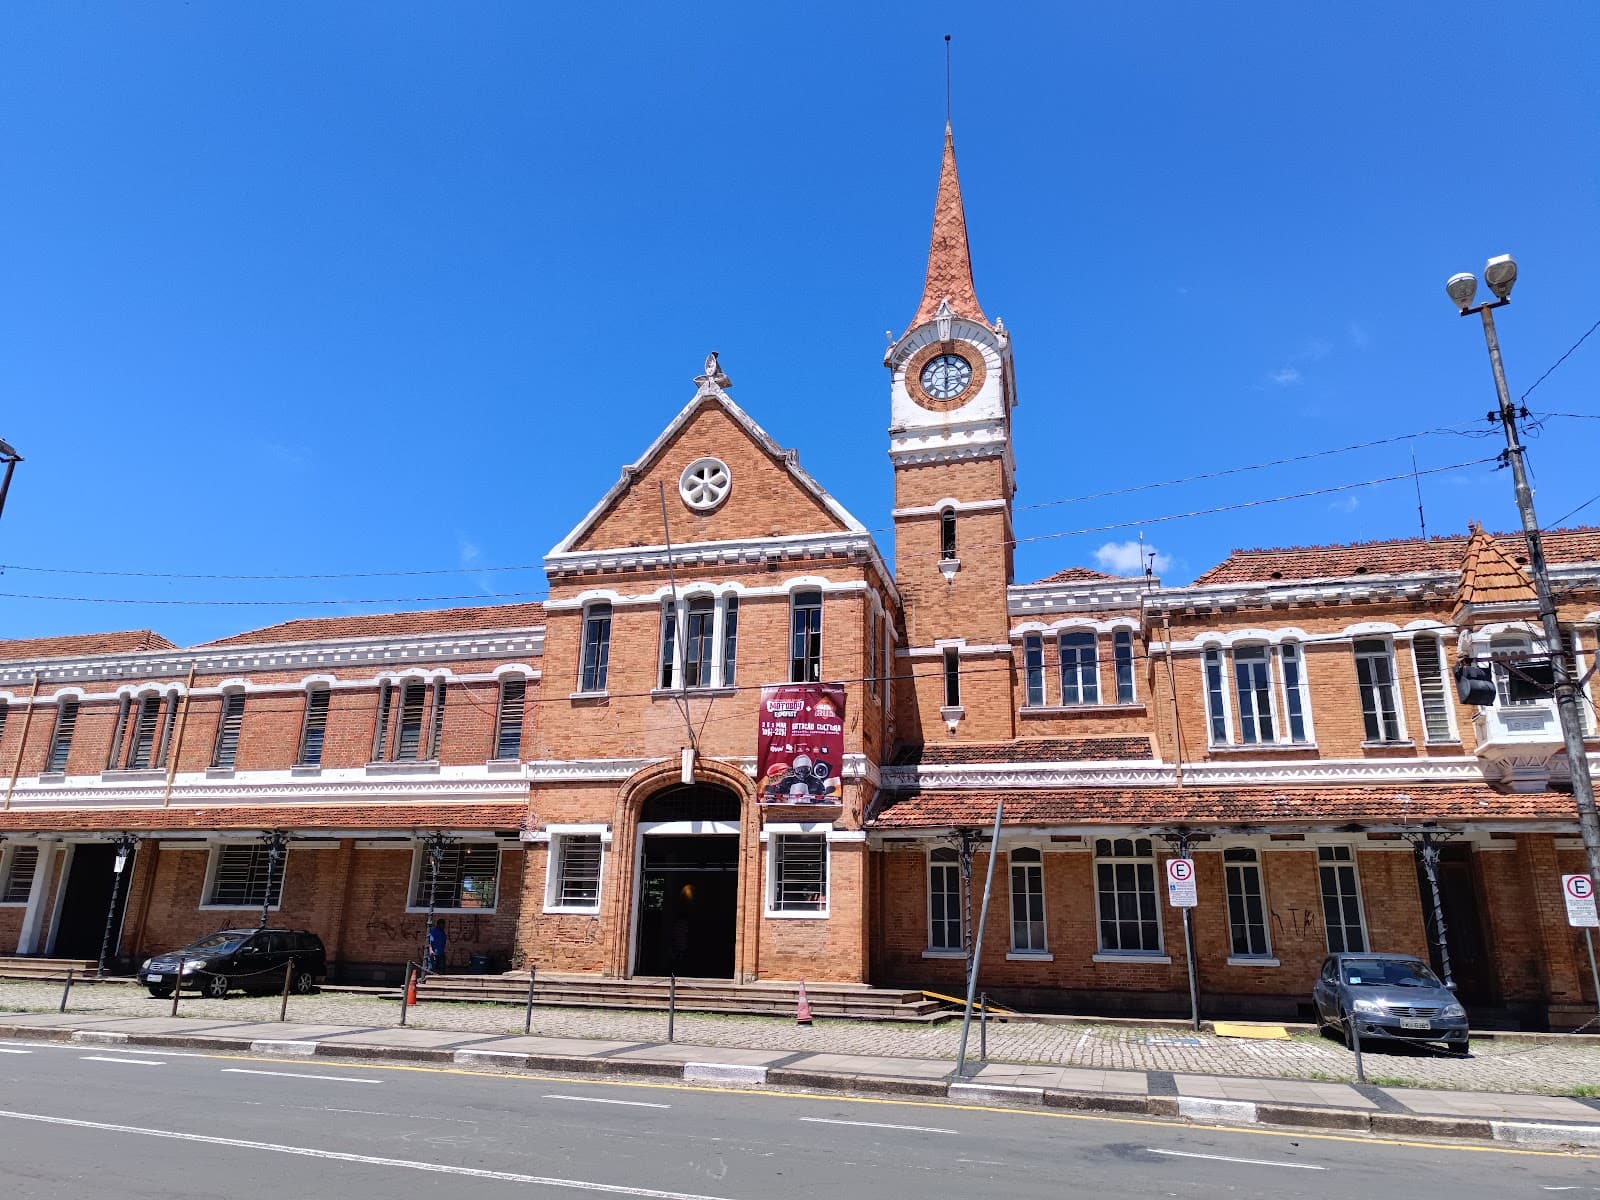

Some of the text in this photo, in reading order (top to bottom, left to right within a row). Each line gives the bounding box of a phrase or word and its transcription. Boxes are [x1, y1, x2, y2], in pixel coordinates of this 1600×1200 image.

[769, 702, 802, 710] MOTOBOY
[1176, 864, 1186, 877] E
[1575, 880, 1587, 894] E
